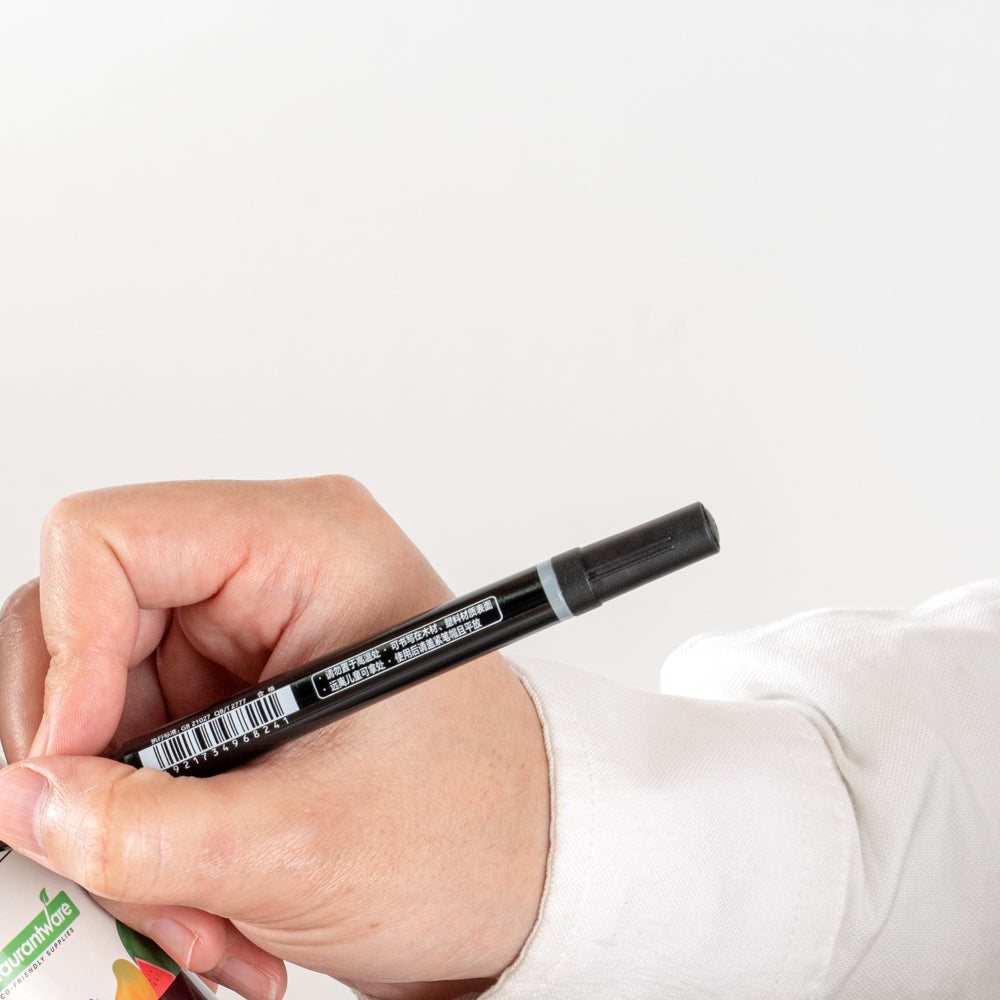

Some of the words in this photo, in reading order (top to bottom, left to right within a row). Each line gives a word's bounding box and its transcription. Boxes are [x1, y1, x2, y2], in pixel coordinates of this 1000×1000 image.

[325, 650, 382, 680] 请勿置于高温处
[329, 661, 386, 692] 远离儿童可拿处
[394, 618, 483, 663] 使用后请盖紧笔帽且平放
[191, 714, 211, 727] 21027
[163, 717, 289, 774] 921734968241
[46, 926, 75, 957] SUPPLIES
